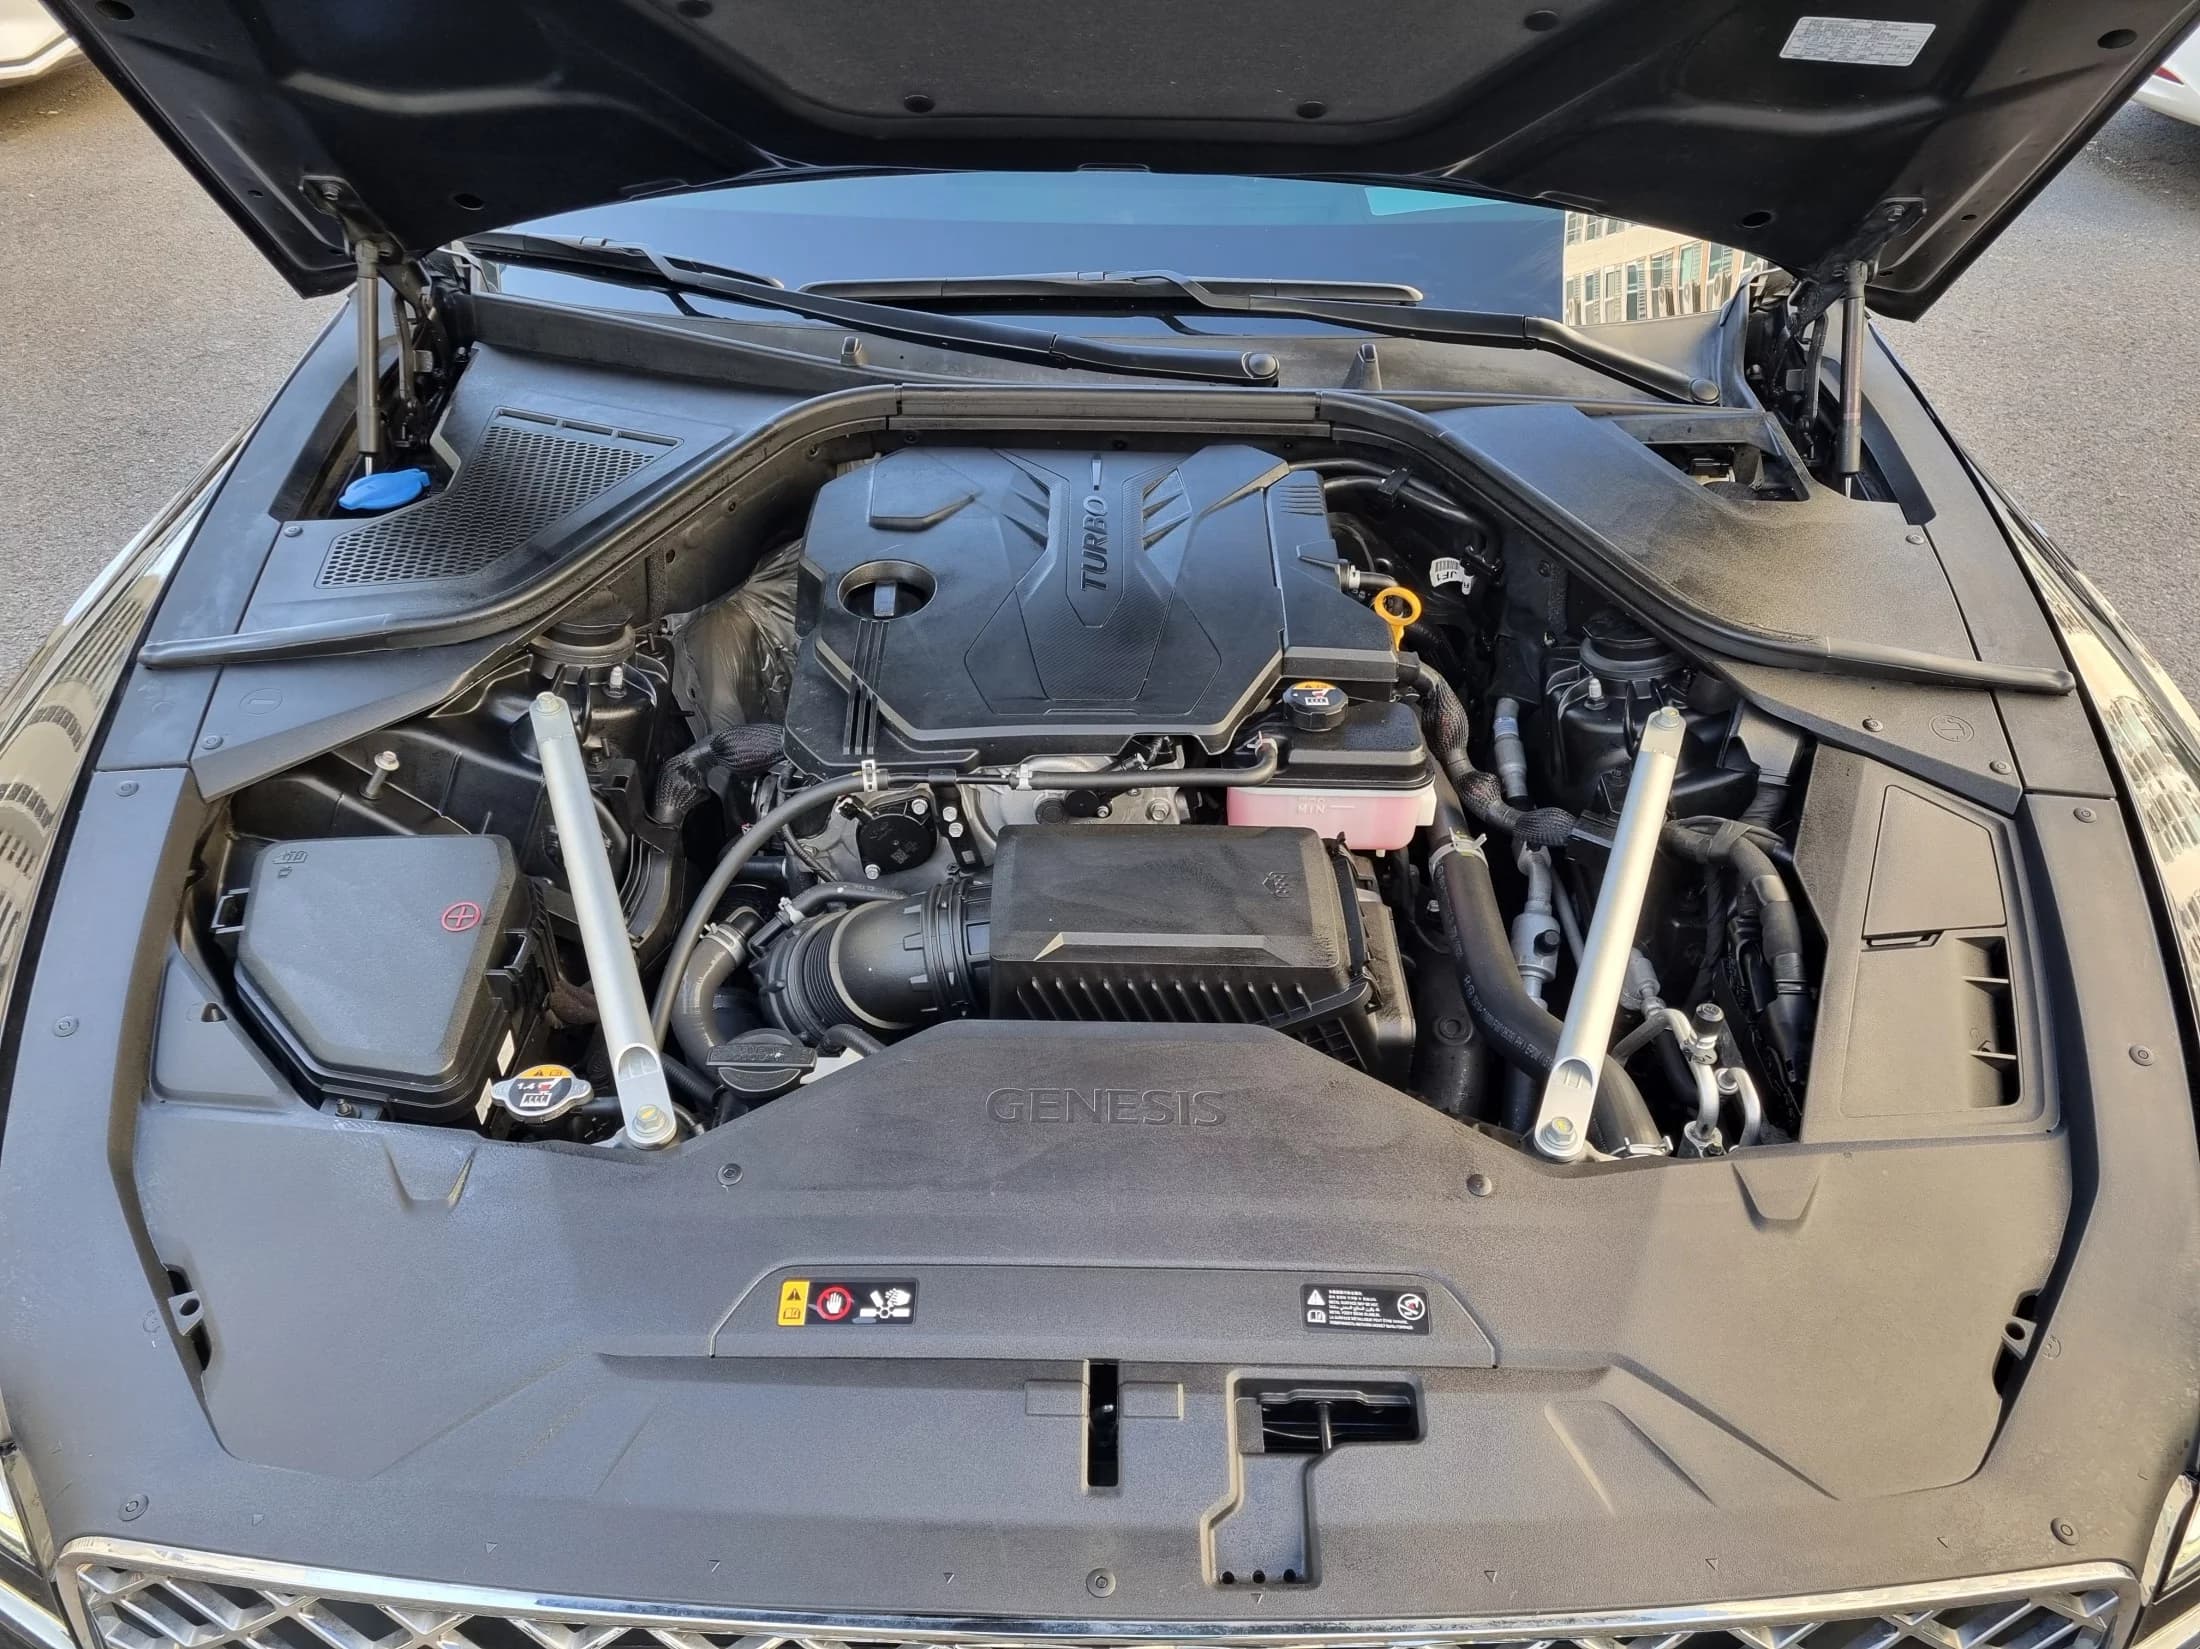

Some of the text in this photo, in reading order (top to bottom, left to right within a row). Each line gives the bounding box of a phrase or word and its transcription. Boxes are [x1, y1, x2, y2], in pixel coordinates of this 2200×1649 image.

[1080, 495, 1108, 592] TURBO
[1297, 803, 1326, 814] MIN
[985, 1087, 1227, 1127] GENESIS
